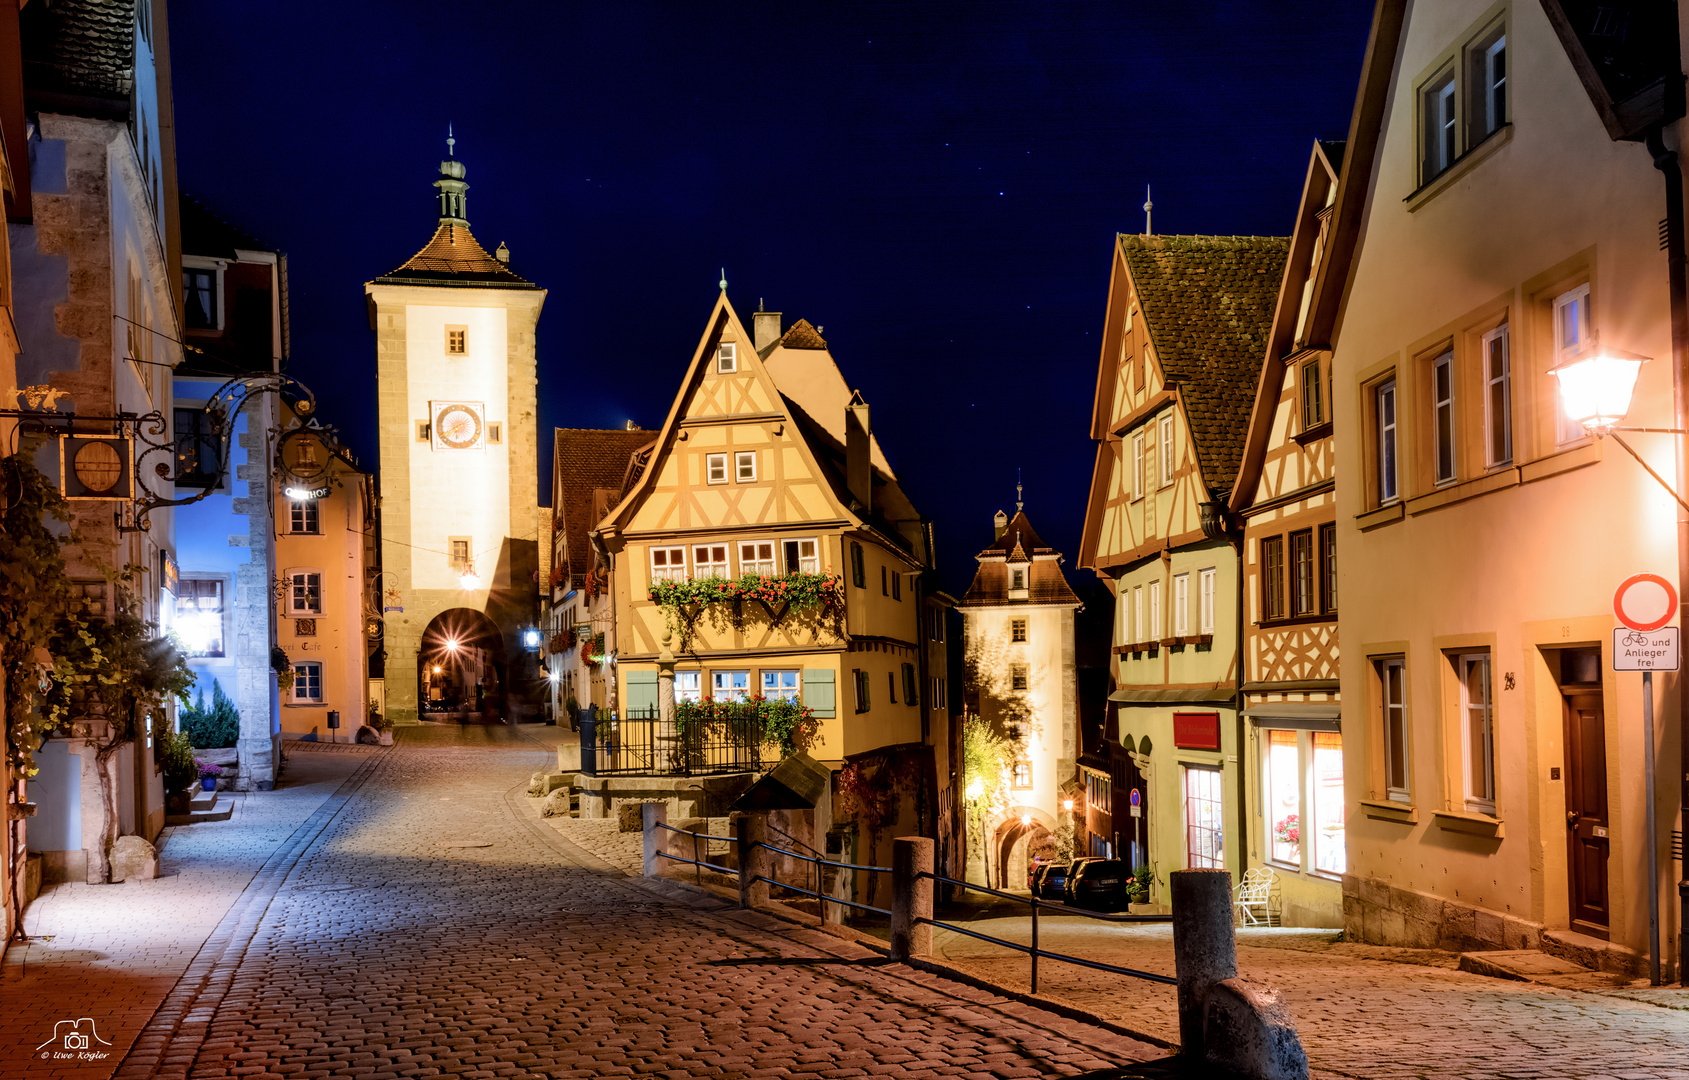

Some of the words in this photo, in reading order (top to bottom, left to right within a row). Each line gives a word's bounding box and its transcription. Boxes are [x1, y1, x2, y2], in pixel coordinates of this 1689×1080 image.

[1652, 638, 1670, 647] und
[1624, 649, 1667, 659] Anlieger
[1637, 659, 1655, 667] frei
